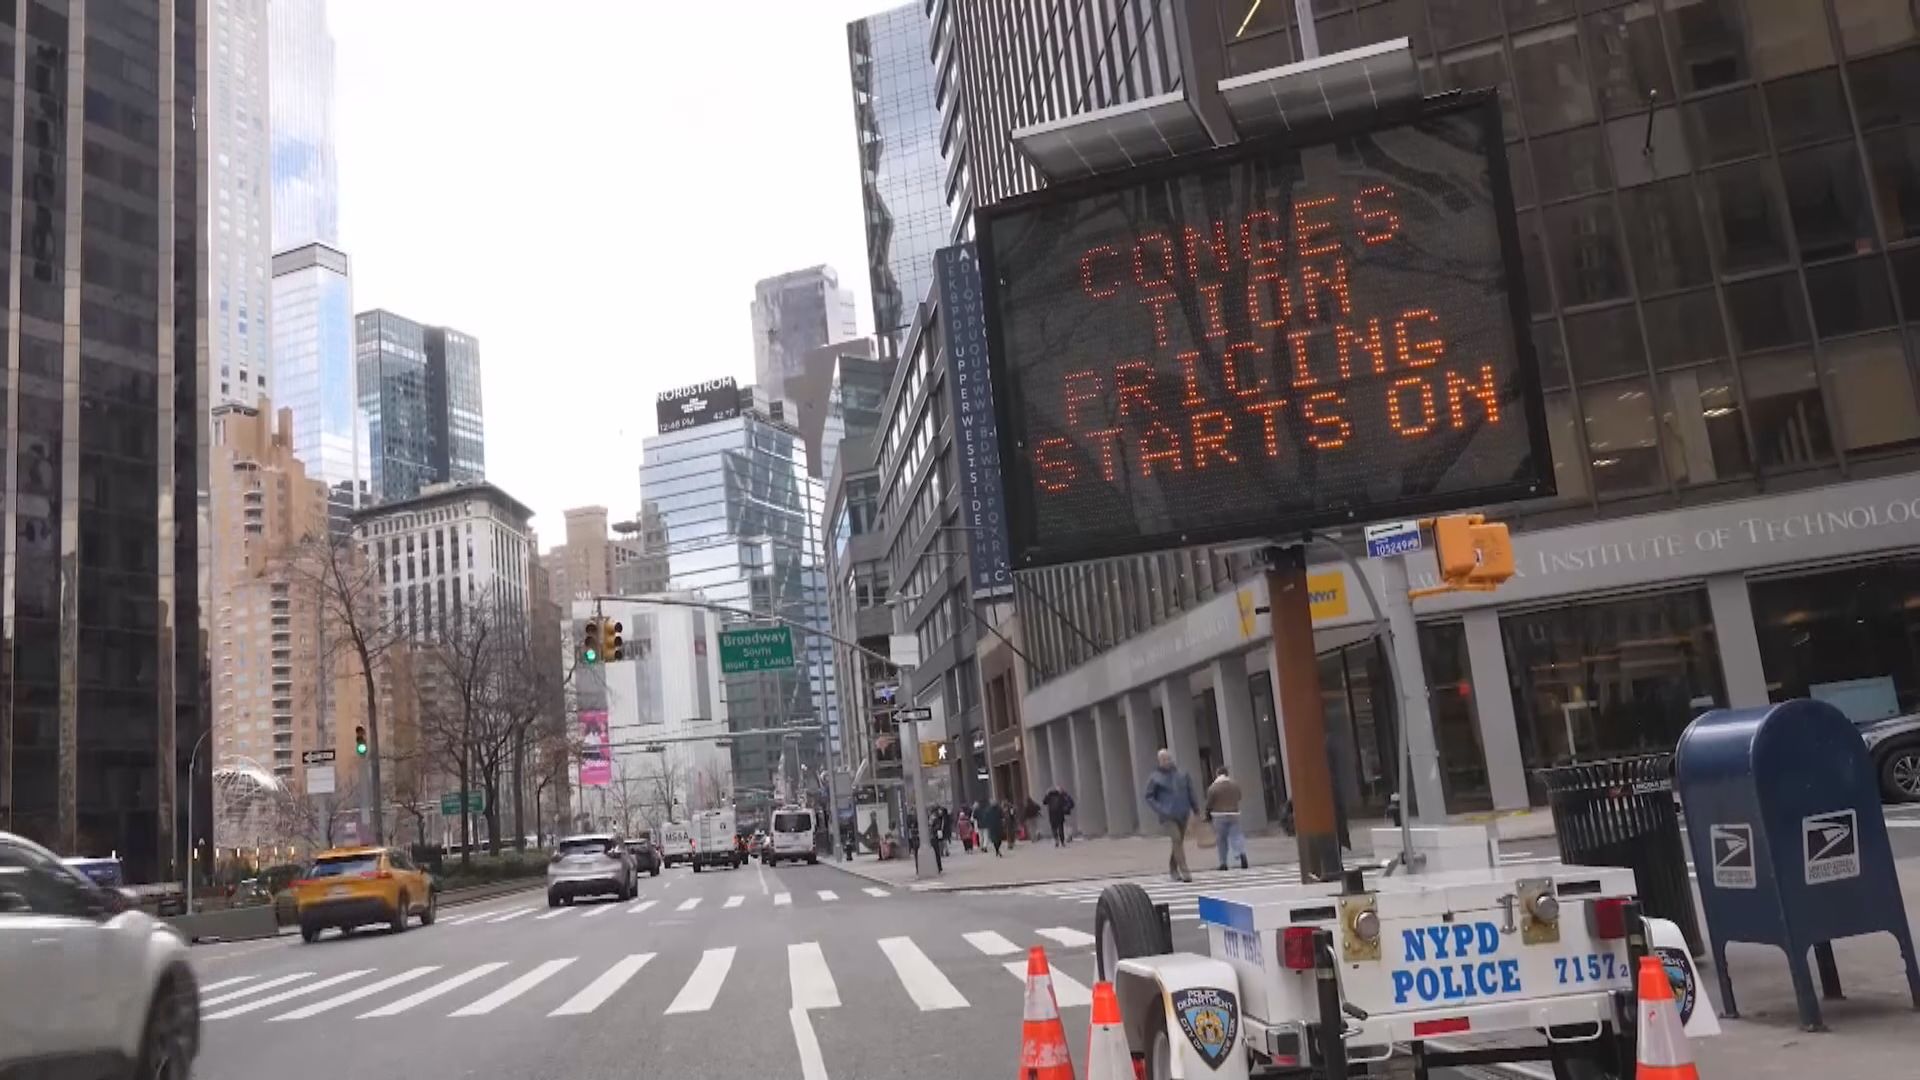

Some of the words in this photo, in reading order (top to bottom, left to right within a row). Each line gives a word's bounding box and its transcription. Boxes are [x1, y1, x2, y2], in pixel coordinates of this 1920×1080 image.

[1080, 184, 1399, 299] CONGES
[1139, 258, 1351, 348] TION
[1064, 309, 1445, 425] PRICING
[1035, 388, 1351, 491] STARTS
[1388, 364, 1499, 436] ON
[1539, 534, 1684, 575] INSTITUTE
[1695, 527, 1729, 551] OF
[723, 631, 786, 647] Broadway
[1402, 922, 1500, 962] NYPD
[1187, 990, 1217, 999] POLICE
[1392, 959, 1522, 1003] POLICE
[1554, 953, 1615, 984] 7157
[1177, 997, 1232, 1012] DEPARTMENT
